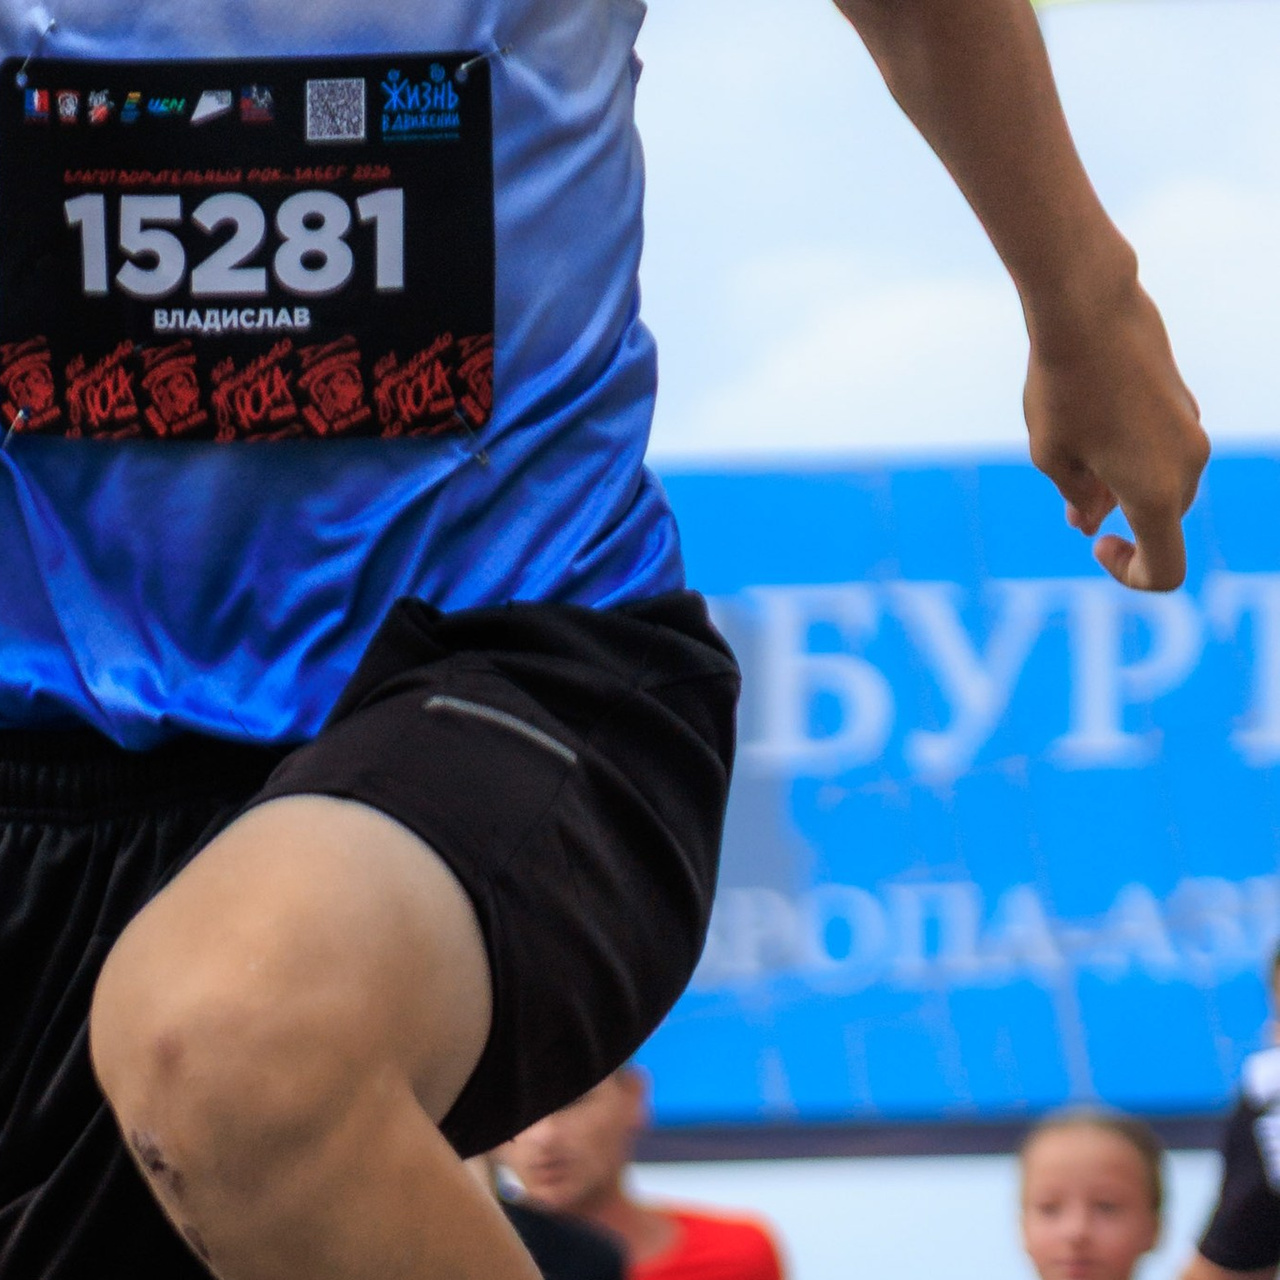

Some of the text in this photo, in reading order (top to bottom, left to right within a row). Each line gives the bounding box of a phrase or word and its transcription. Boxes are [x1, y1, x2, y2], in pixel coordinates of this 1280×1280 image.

[381, 76, 459, 112] ЖИЗНЬ
[64, 188, 404, 294] 15281
[154, 307, 311, 331] ВЛАДИСЛАВ
